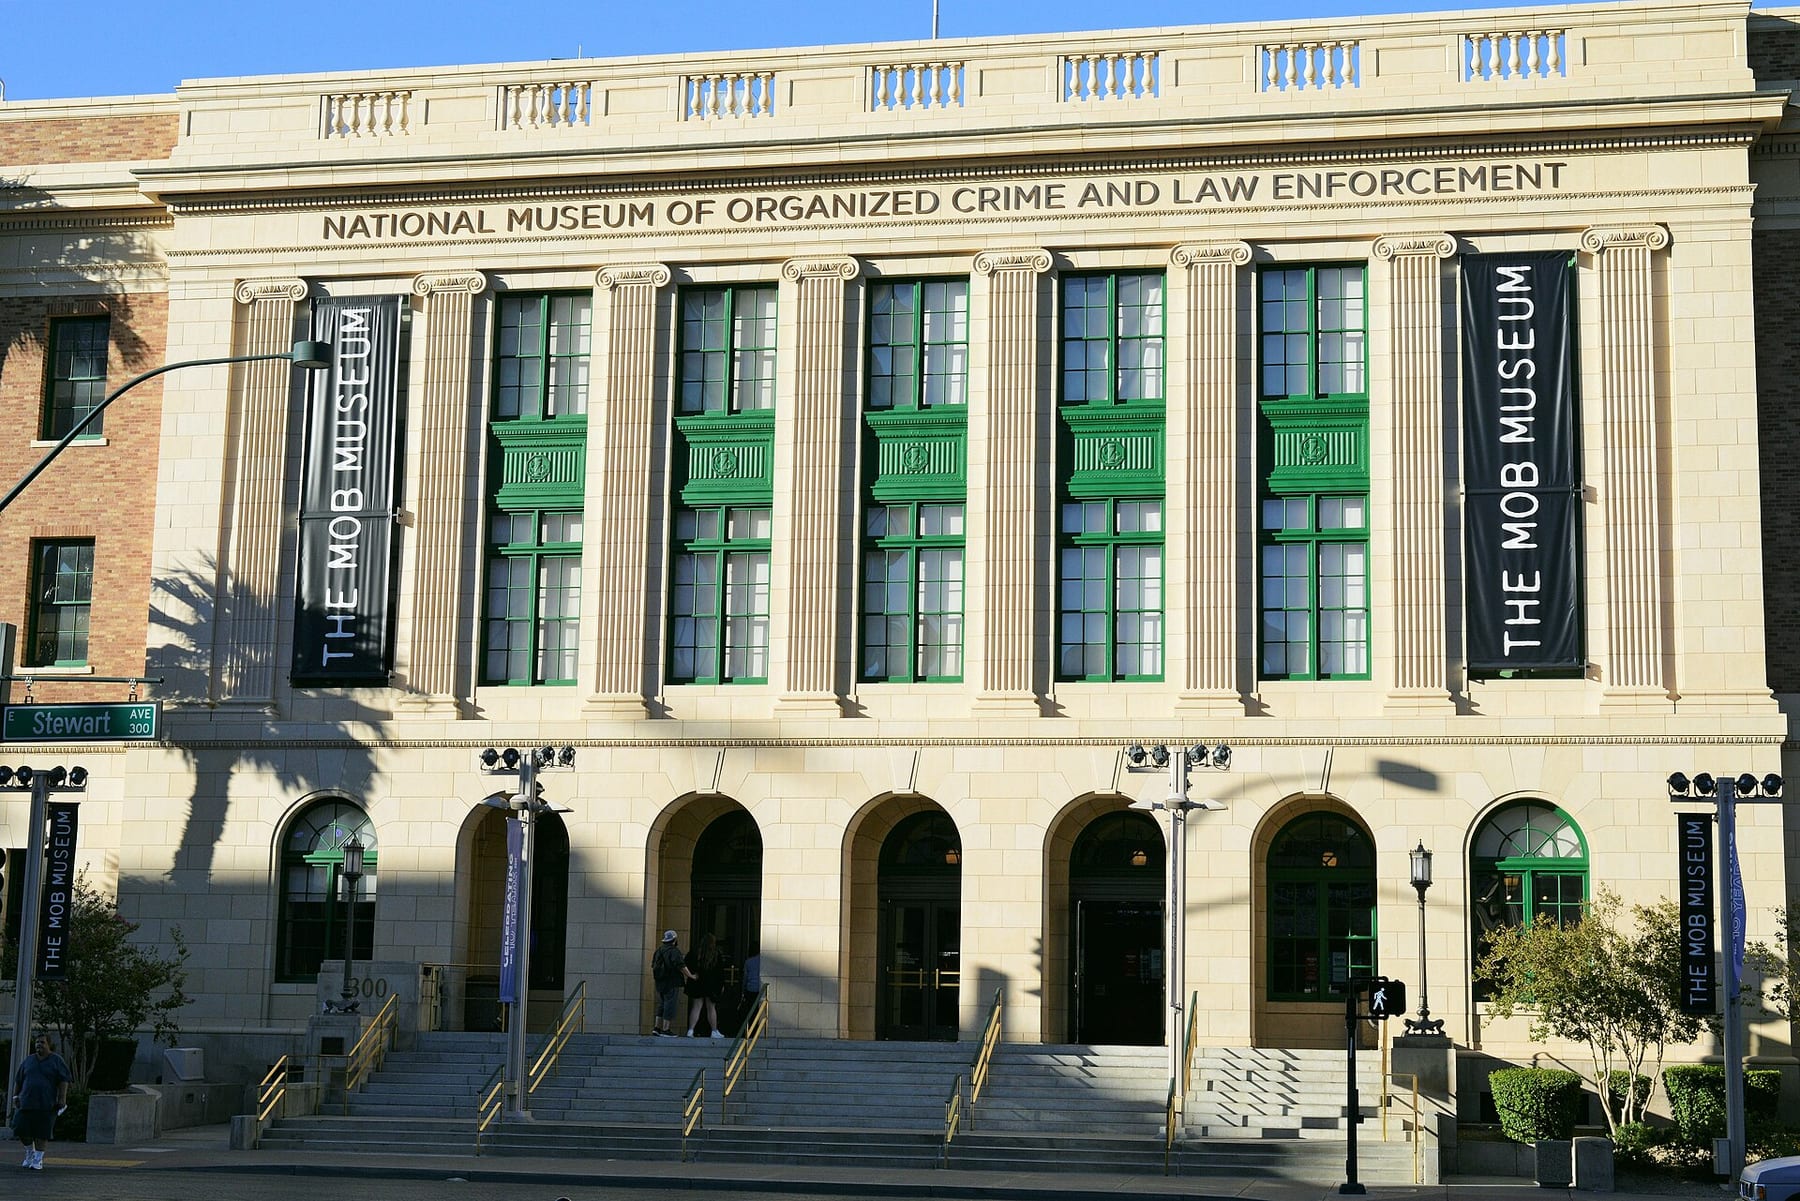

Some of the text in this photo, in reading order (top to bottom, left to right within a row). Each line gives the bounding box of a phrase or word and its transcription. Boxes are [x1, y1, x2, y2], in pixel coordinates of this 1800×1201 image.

[322, 162, 1568, 241] NATIONAL MUSEUM OF ORGANIZED CRIME AND LAW ENFORCEMENT
[322, 307, 372, 668] THE MOB MUSEUM
[1495, 264, 1542, 657] THE MOB MUSEUM
[8, 711, 15, 722] E
[32, 711, 111, 735] Stewart
[129, 708, 151, 719] AVE
[129, 723, 150, 734] 300
[45, 811, 71, 972] THE MOB MUSEUM
[1686, 821, 1708, 1006] THE MOB MUSEUM
